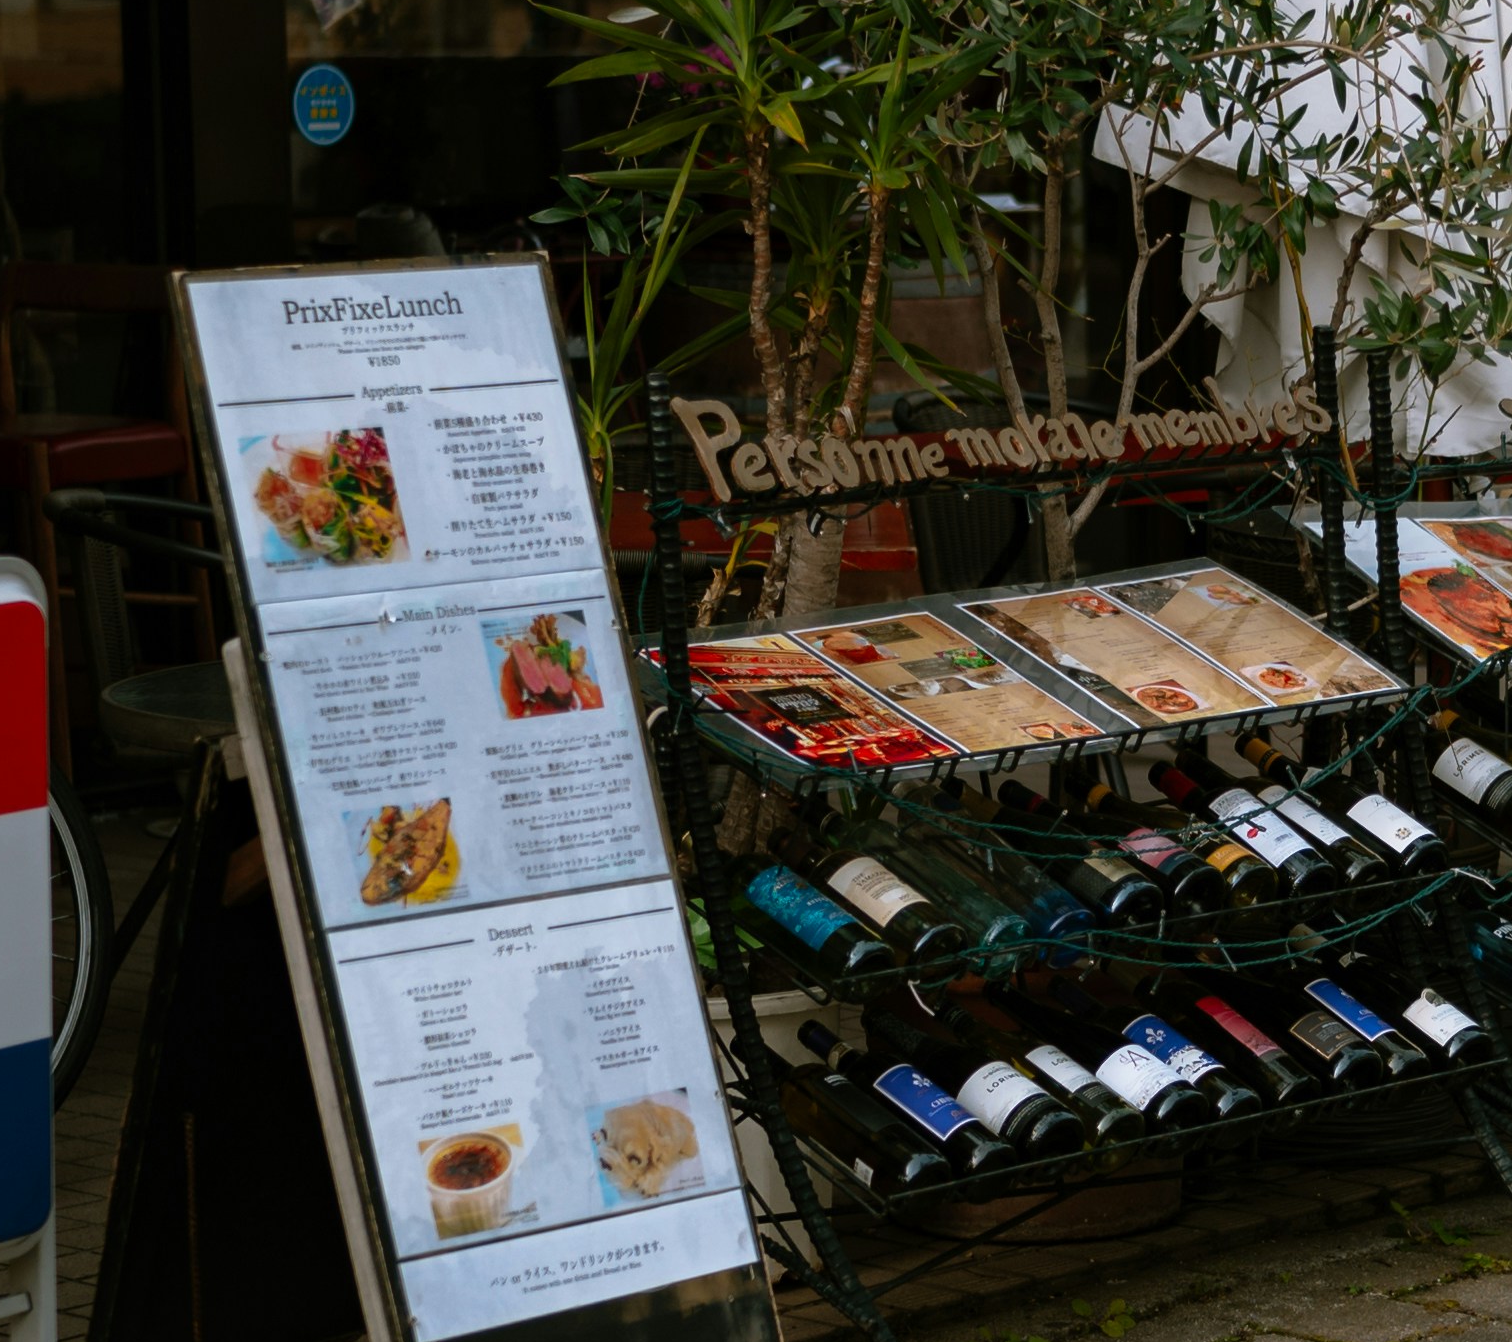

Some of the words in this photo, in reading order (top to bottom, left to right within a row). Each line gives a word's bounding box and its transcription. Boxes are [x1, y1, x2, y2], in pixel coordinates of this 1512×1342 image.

[282, 291, 464, 325] PrixFixeLunch
[361, 384, 424, 401] Appetizers
[669, 396, 950, 503] Personne
[402, 609, 434, 622] Main
[437, 603, 477, 618] Dishes
[488, 924, 534, 942] Dessert
